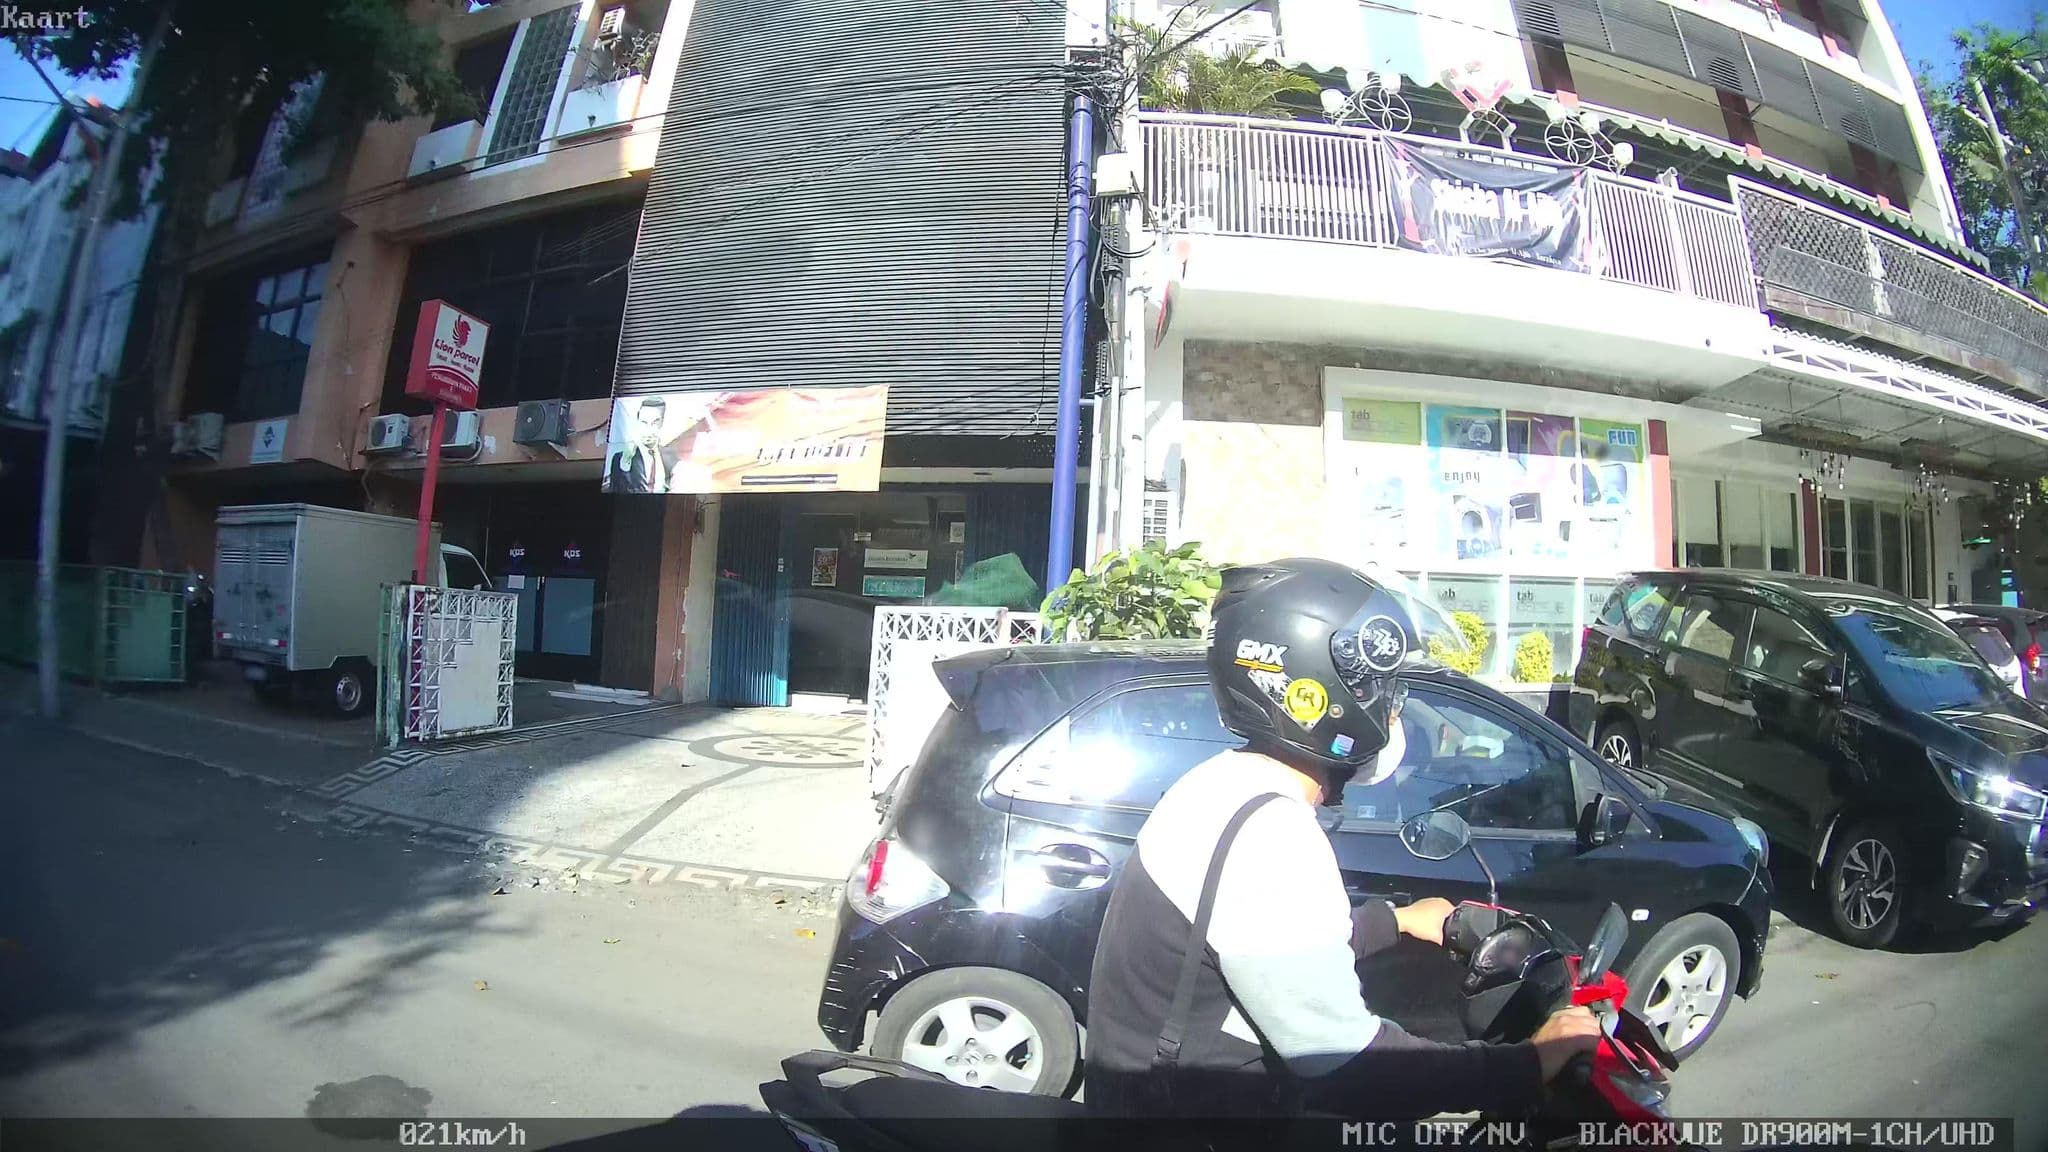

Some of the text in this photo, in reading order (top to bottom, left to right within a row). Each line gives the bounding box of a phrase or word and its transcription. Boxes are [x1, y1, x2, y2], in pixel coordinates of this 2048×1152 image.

[435, 338, 454, 355] Lion
[454, 349, 480, 366] parcel
[1350, 409, 1370, 420] tab
[1444, 471, 1480, 483] enjoy
